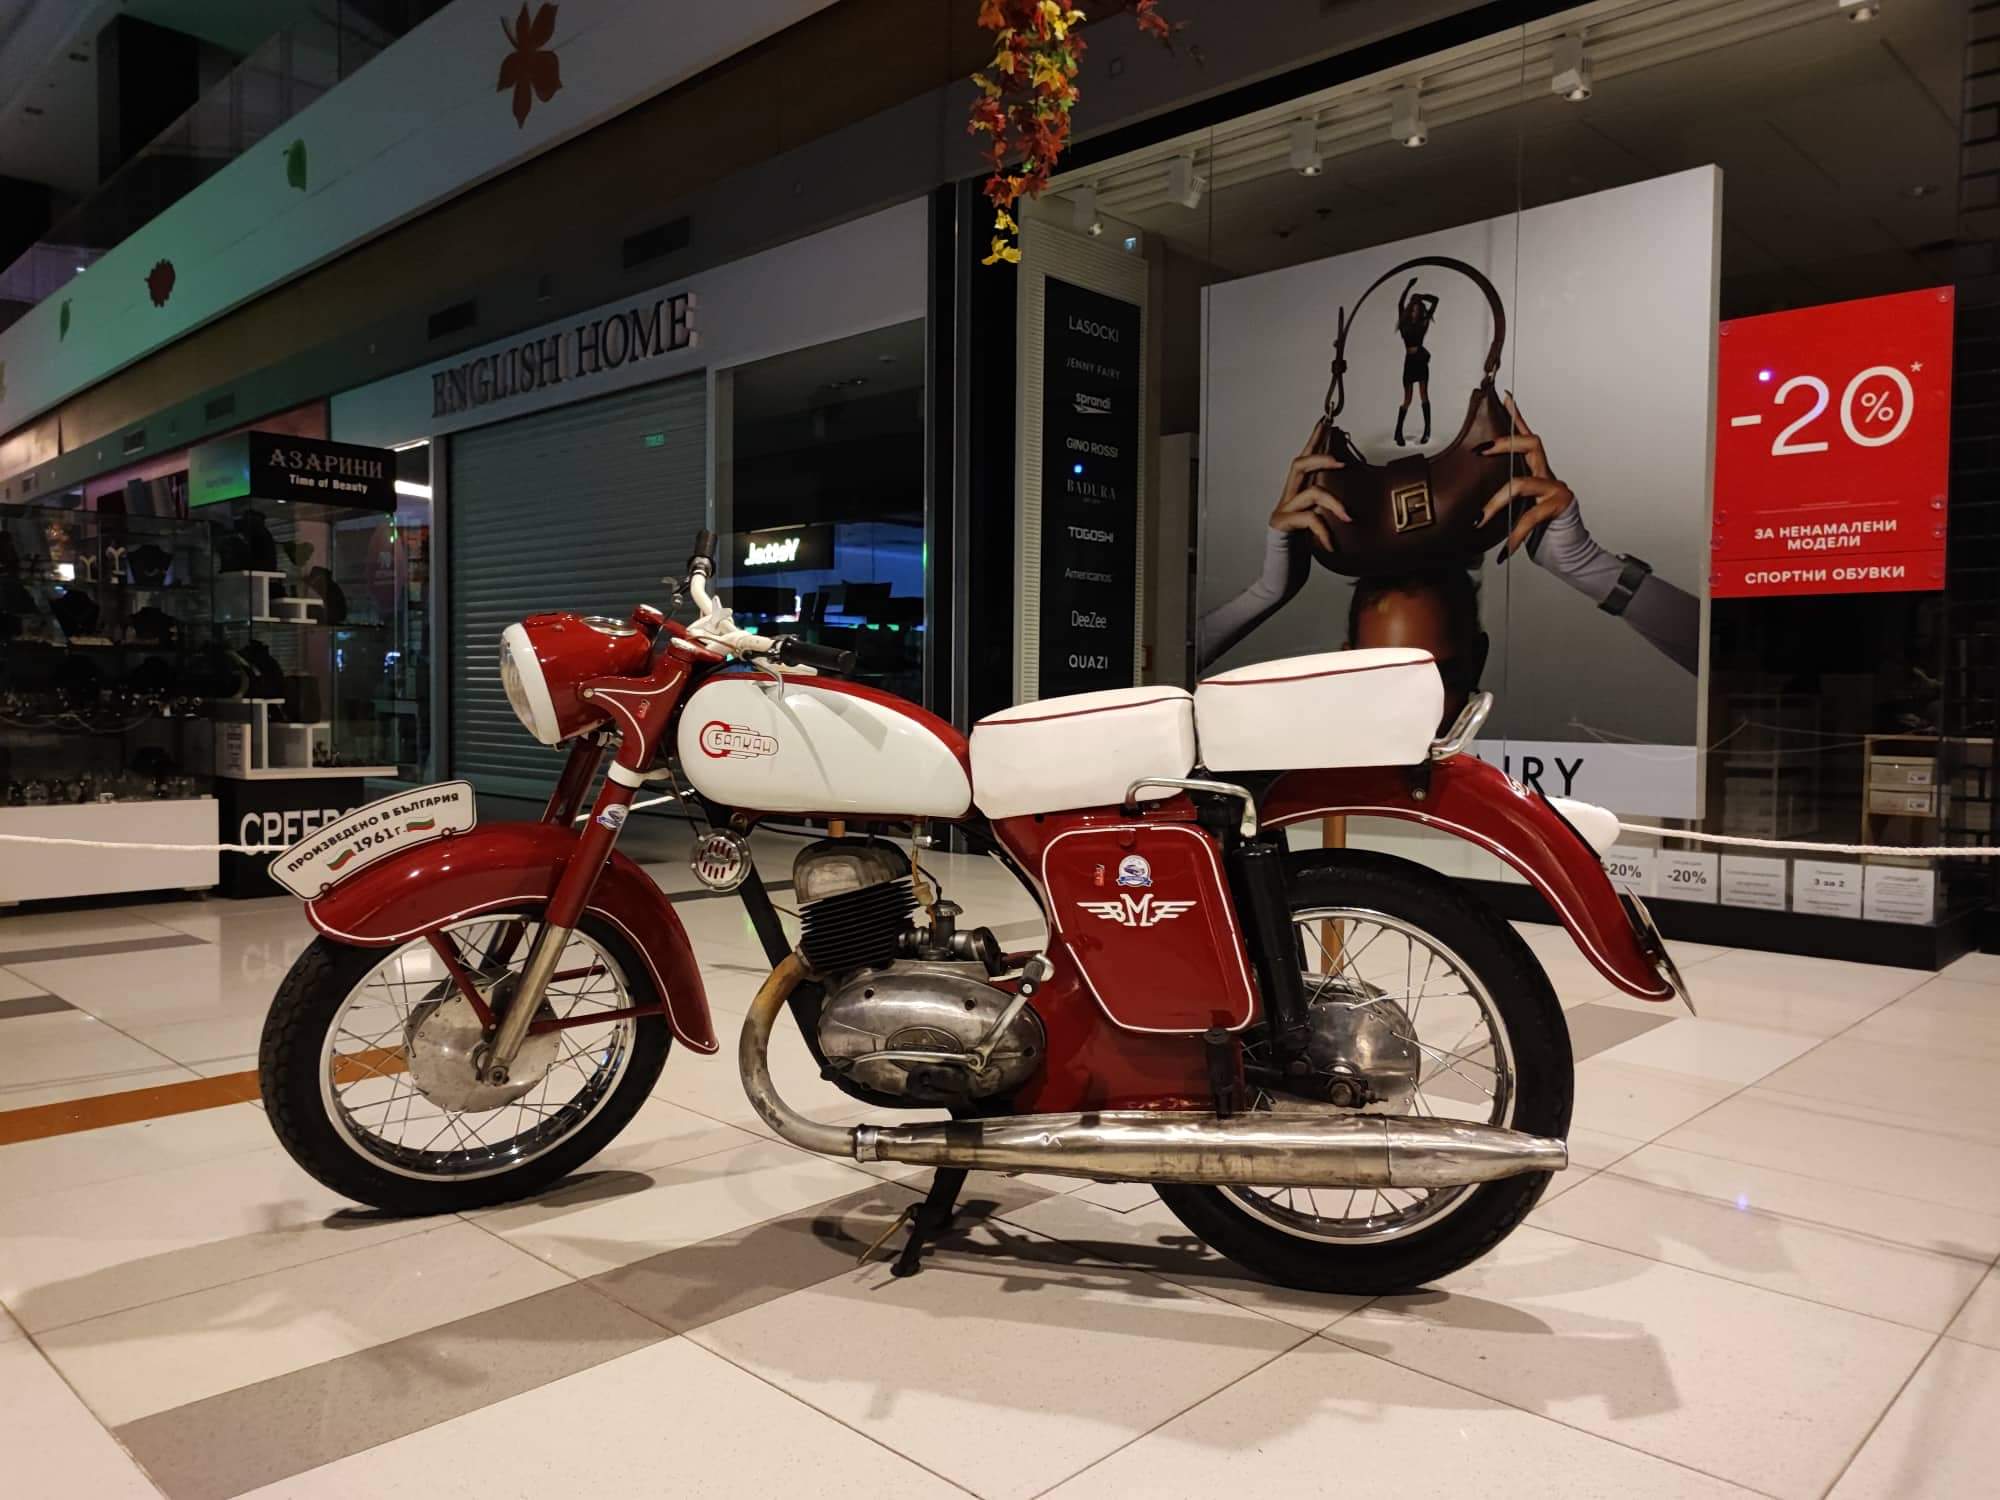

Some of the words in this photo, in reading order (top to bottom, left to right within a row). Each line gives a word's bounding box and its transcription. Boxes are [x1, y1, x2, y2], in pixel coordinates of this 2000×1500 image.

[1068, 314, 1119, 343] LASOCKI
[432, 332, 570, 418] ENGLISH
[575, 291, 698, 378] HOME
[1075, 392, 1111, 410] sprandi
[1065, 436, 1089, 453] GINO
[1091, 441, 1119, 458] ROSSI
[269, 449, 384, 479] АЗАРИНИ
[289, 473, 315, 487] Time
[318, 477, 330, 488] of
[333, 479, 369, 494] Beauty
[1066, 479, 1116, 501] BADURA
[1067, 526, 1114, 543] TOGOSHI
[1754, 527, 1775, 540] ЗА
[1779, 519, 1898, 538] НЕНАМАЛЕНИ
[1787, 535, 1862, 551] МОДЕЛИ
[1064, 567, 1112, 583] Americanos
[1744, 568, 1826, 585] СПОРТНИ
[1832, 566, 1905, 582] ОБУВКИ
[1071, 610, 1107, 629] DeeZee
[1068, 654, 1109, 670] QUAZI
[240, 808, 356, 856] СРЕБ
[288, 816, 379, 873] ПРОИЗВЕДЕНО
[381, 811, 391, 820] В
[394, 792, 460, 817] БЪЛГАРИЯ
[1667, 869, 1707, 885] -20%
